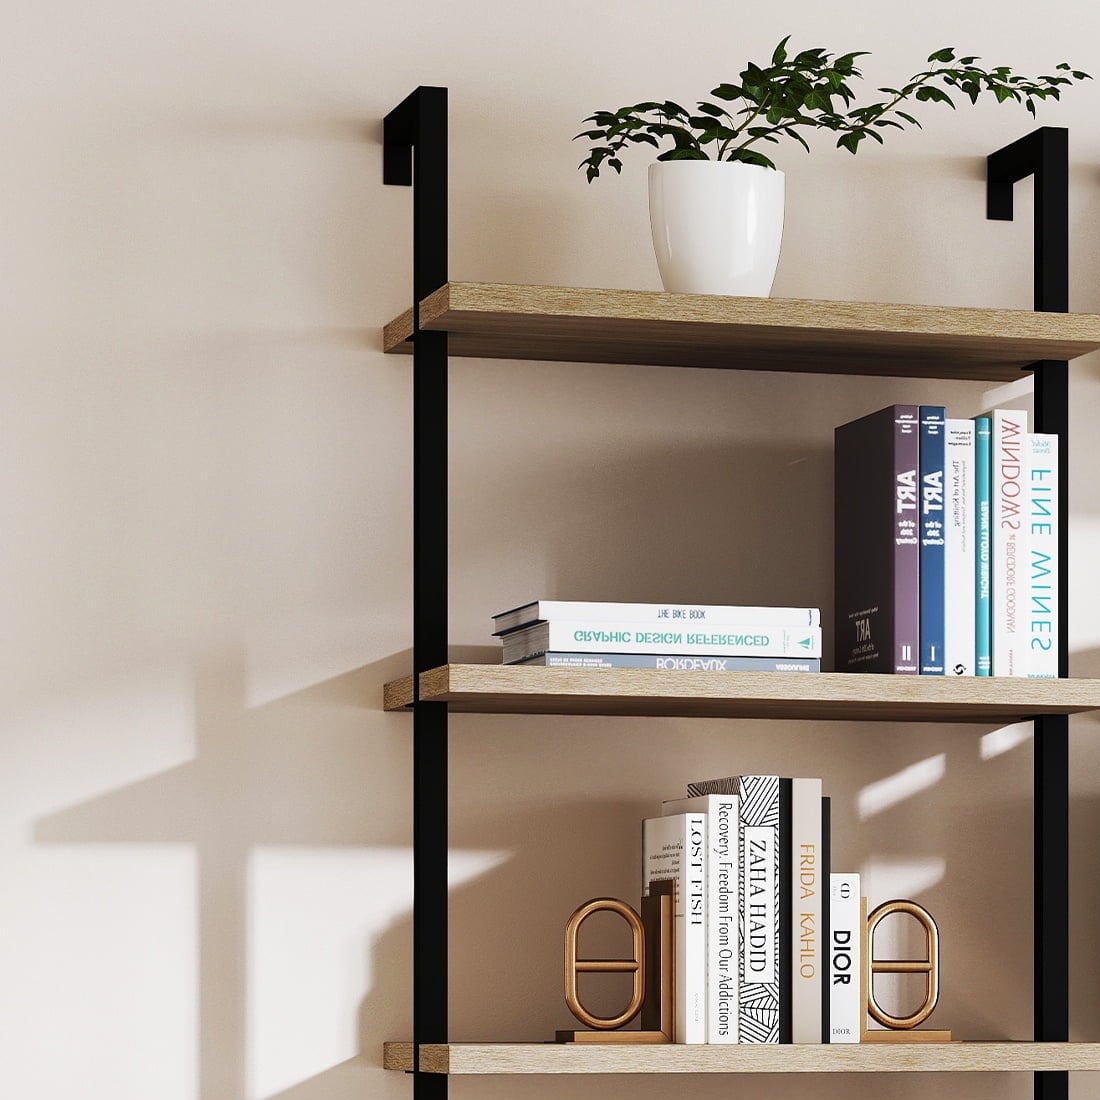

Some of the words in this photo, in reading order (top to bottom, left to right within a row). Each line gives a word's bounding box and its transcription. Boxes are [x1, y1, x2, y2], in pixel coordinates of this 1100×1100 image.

[691, 820, 702, 869] LOST
[750, 840, 766, 897] ZAHA
[718, 863, 732, 912] Freedom
[800, 845, 815, 899] FRIDA
[691, 880, 702, 925] FISH
[718, 915, 732, 947] From
[750, 904, 766, 973] HADID
[800, 914, 815, 979] KAHLO
[833, 931, 851, 985] DIOR
[718, 949, 732, 972] Our
[718, 974, 732, 1036] Addictions
